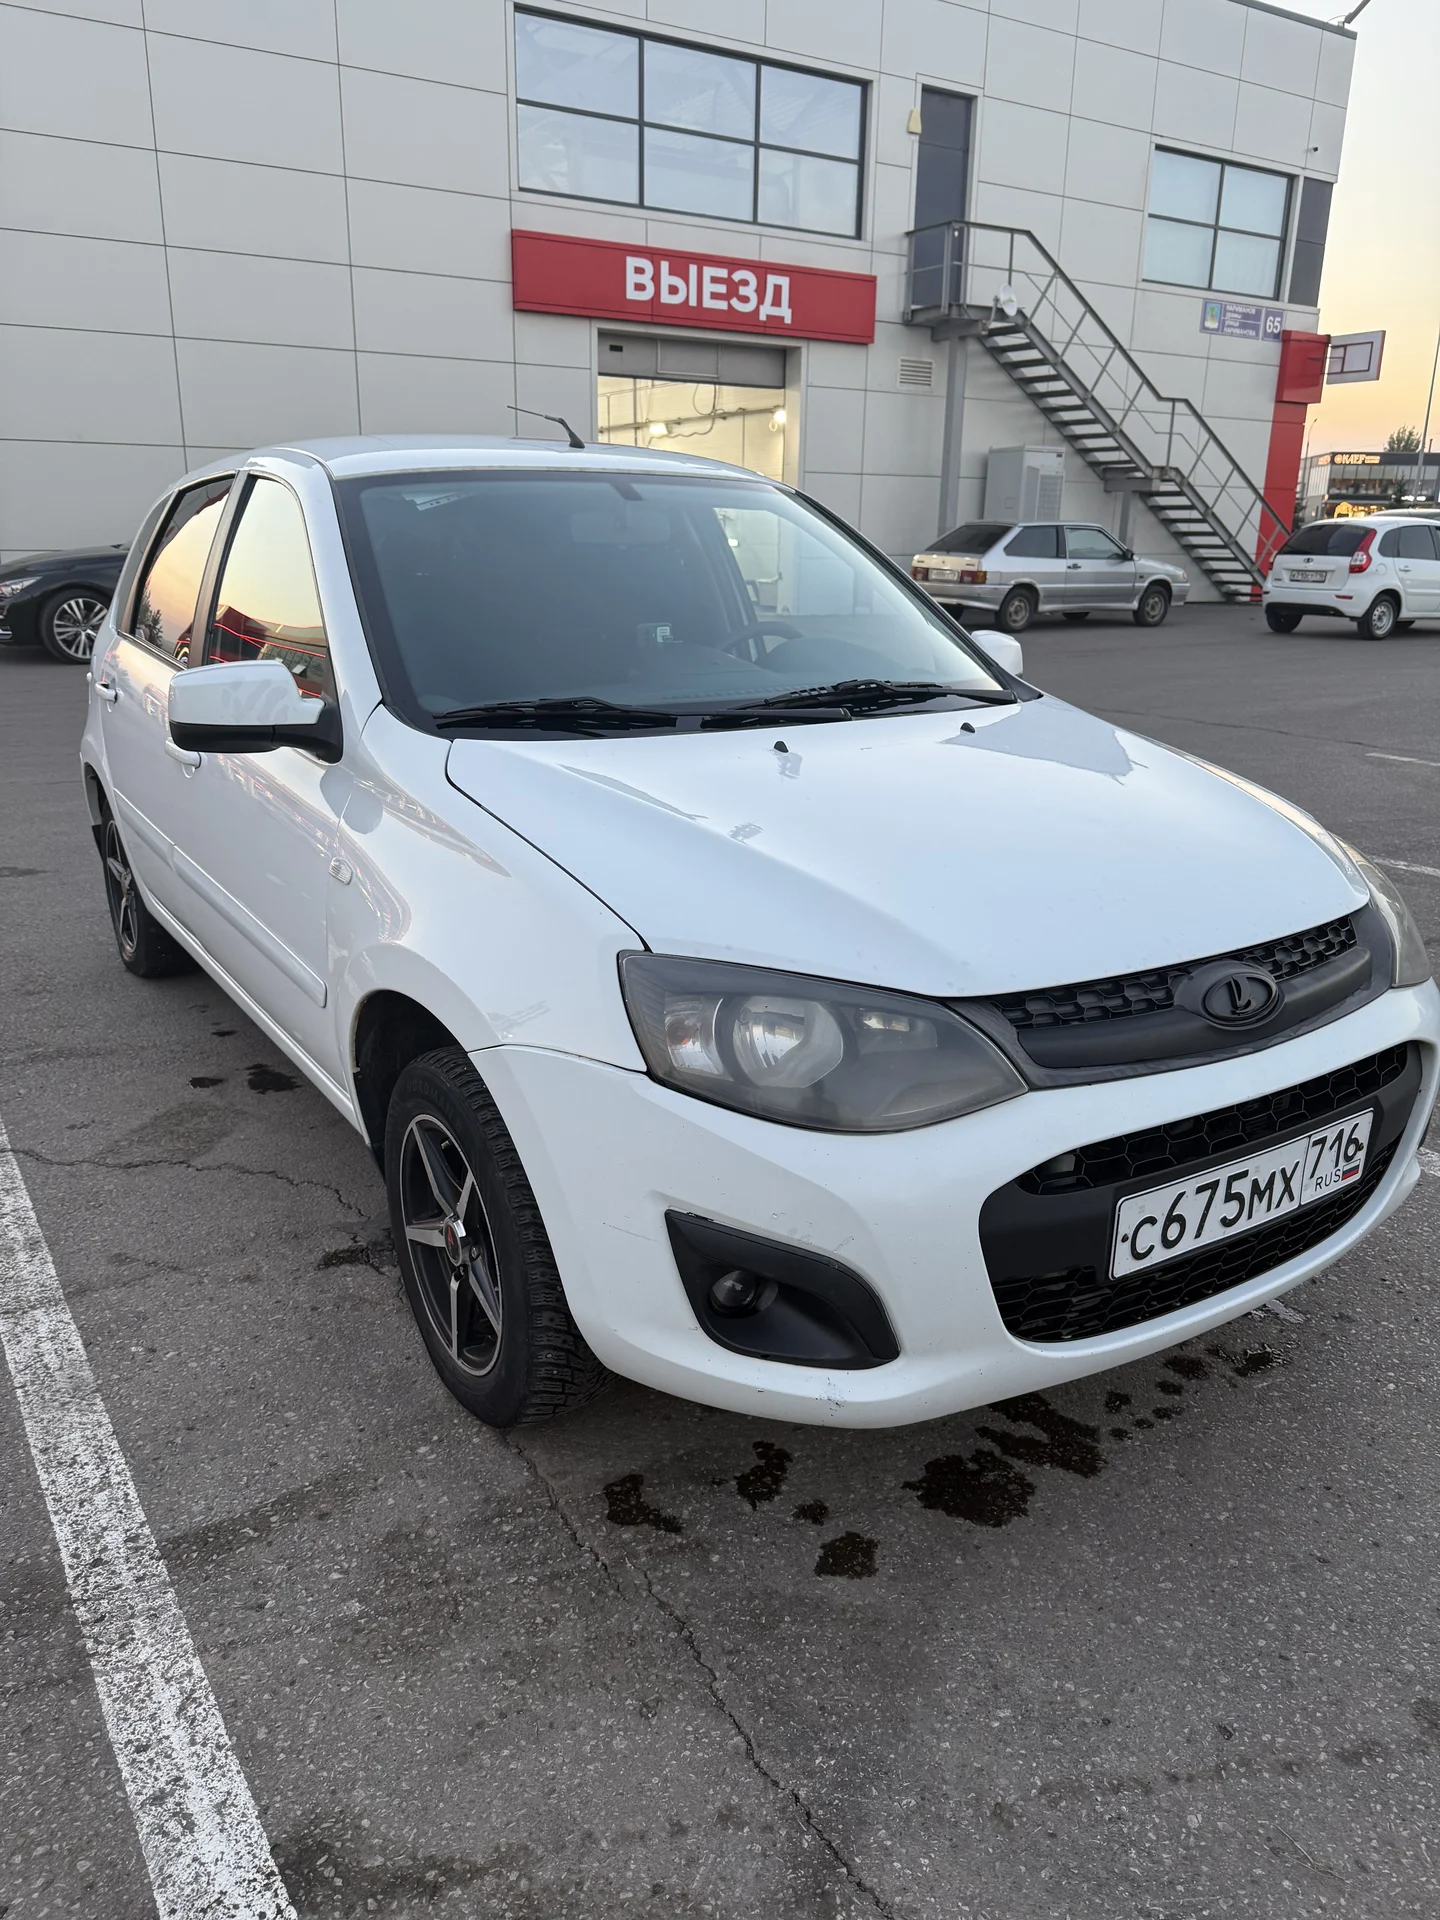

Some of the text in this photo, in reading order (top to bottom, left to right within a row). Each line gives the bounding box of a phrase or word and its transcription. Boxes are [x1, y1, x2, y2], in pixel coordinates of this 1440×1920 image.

[625, 255, 792, 324] ВЫЕЗД
[1266, 316, 1281, 334] 65
[1130, 1122, 1360, 1261] С675МХ 716
[1314, 1168, 1341, 1192] RUS
